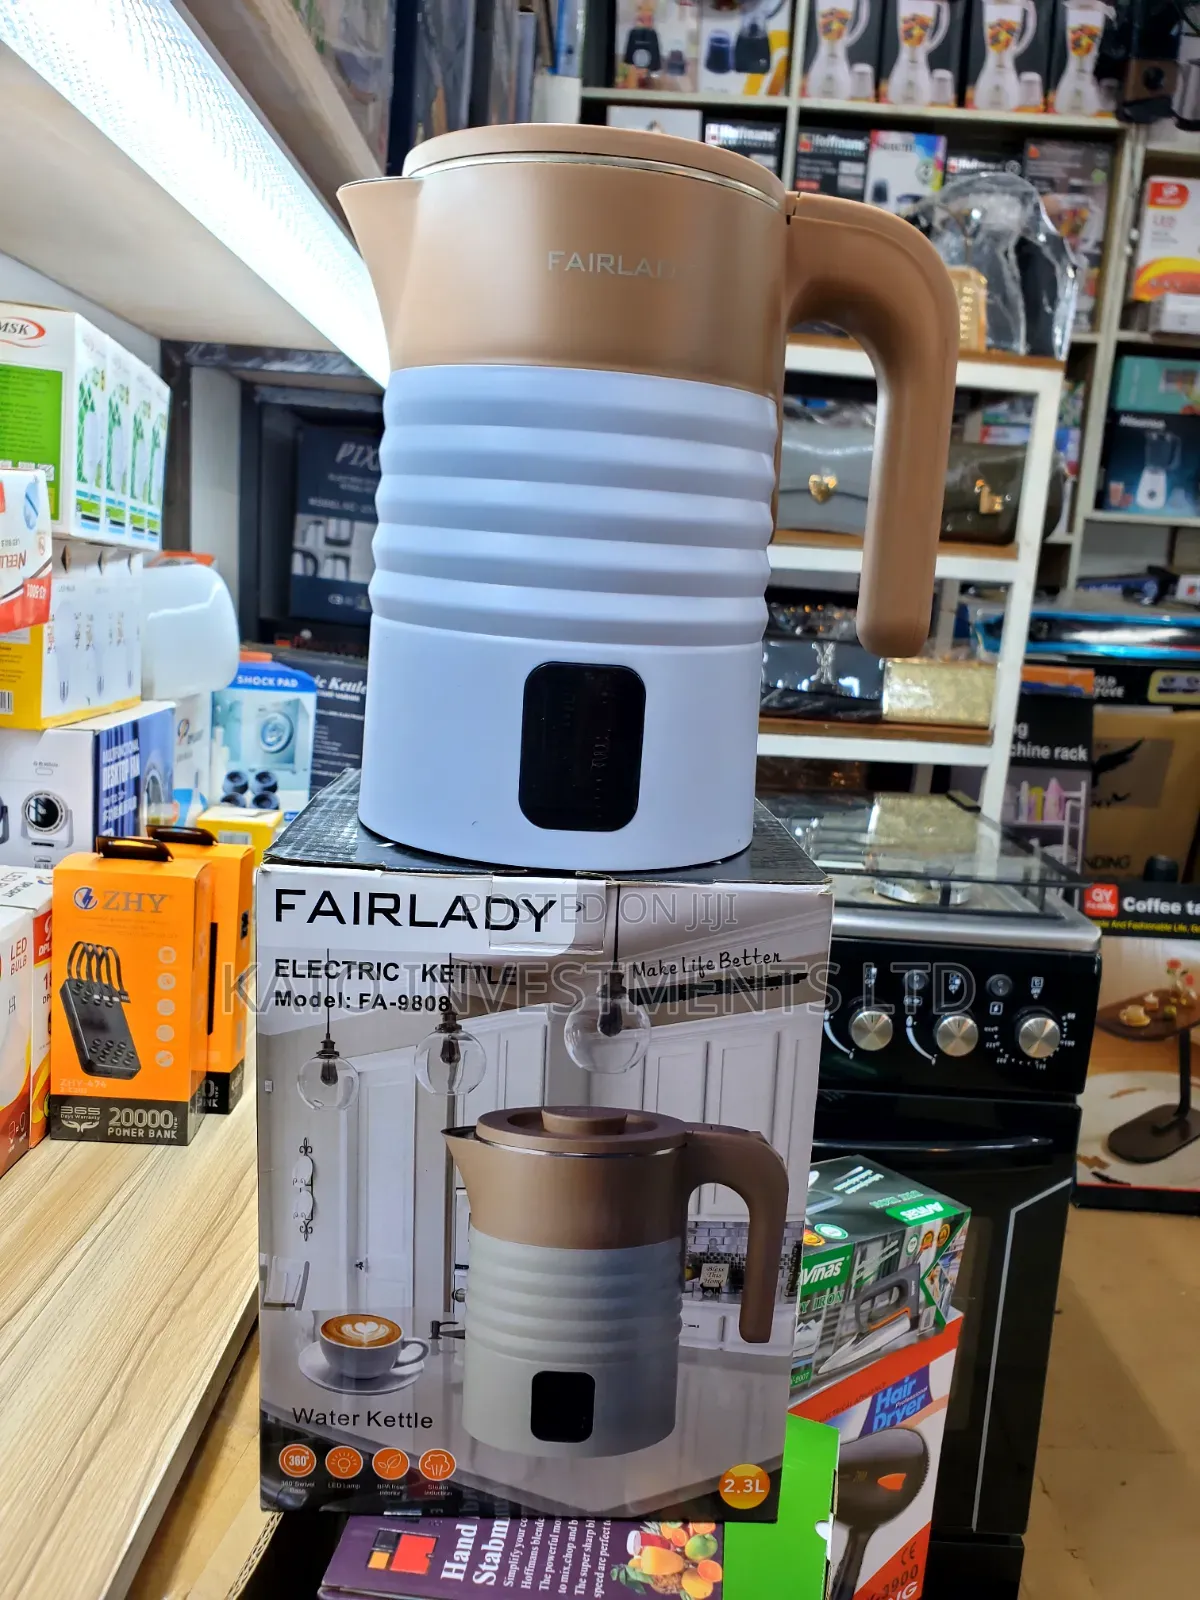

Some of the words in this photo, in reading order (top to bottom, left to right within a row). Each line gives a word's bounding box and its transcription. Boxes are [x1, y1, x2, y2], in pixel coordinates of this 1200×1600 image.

[237, 674, 276, 686] SHOCK
[277, 677, 299, 688] PAD
[1053, 745, 1088, 762] rack
[102, 889, 169, 914] ZHY
[275, 888, 557, 933] FAIRLADY
[1122, 896, 1182, 915] Coffee
[10, 936, 28, 959] LED
[10, 955, 28, 977] BULB
[275, 958, 400, 982] ELECTRIC
[420, 963, 518, 987] KETTLE
[632, 961, 678, 979] Make
[682, 955, 715, 980] Life
[718, 946, 783, 968] Better
[274, 990, 351, 1009] Model:
[358, 992, 450, 1012] FA-9808
[60, 1105, 101, 1116] 365
[74, 1113, 101, 1121] Warranty
[108, 1106, 174, 1129] 20000
[107, 1127, 145, 1138] POWER
[148, 1128, 178, 1140] BANK
[812, 1289, 844, 1312] IRON
[875, 1376, 917, 1414] Hair
[292, 1407, 360, 1426] Water
[366, 1410, 434, 1429] Kettle
[872, 1392, 926, 1433] Dryer
[723, 1477, 765, 1495] 2.3L
[512, 1528, 527, 1549] your
[583, 1529, 599, 1553] sharp
[597, 1526, 614, 1557] perfect
[440, 1523, 478, 1583] Hand
[544, 1535, 562, 1574] powerful
[557, 1584, 568, 1594] to
[565, 1525, 578, 1542] and
[503, 1547, 524, 1588] Simplify
[520, 1546, 540, 1590] Hoffmans
[580, 1552, 594, 1578] super
[597, 1557, 608, 1573] are
[538, 1573, 552, 1592] The
[574, 1577, 588, 1596] The
[592, 1571, 608, 1599] speed
